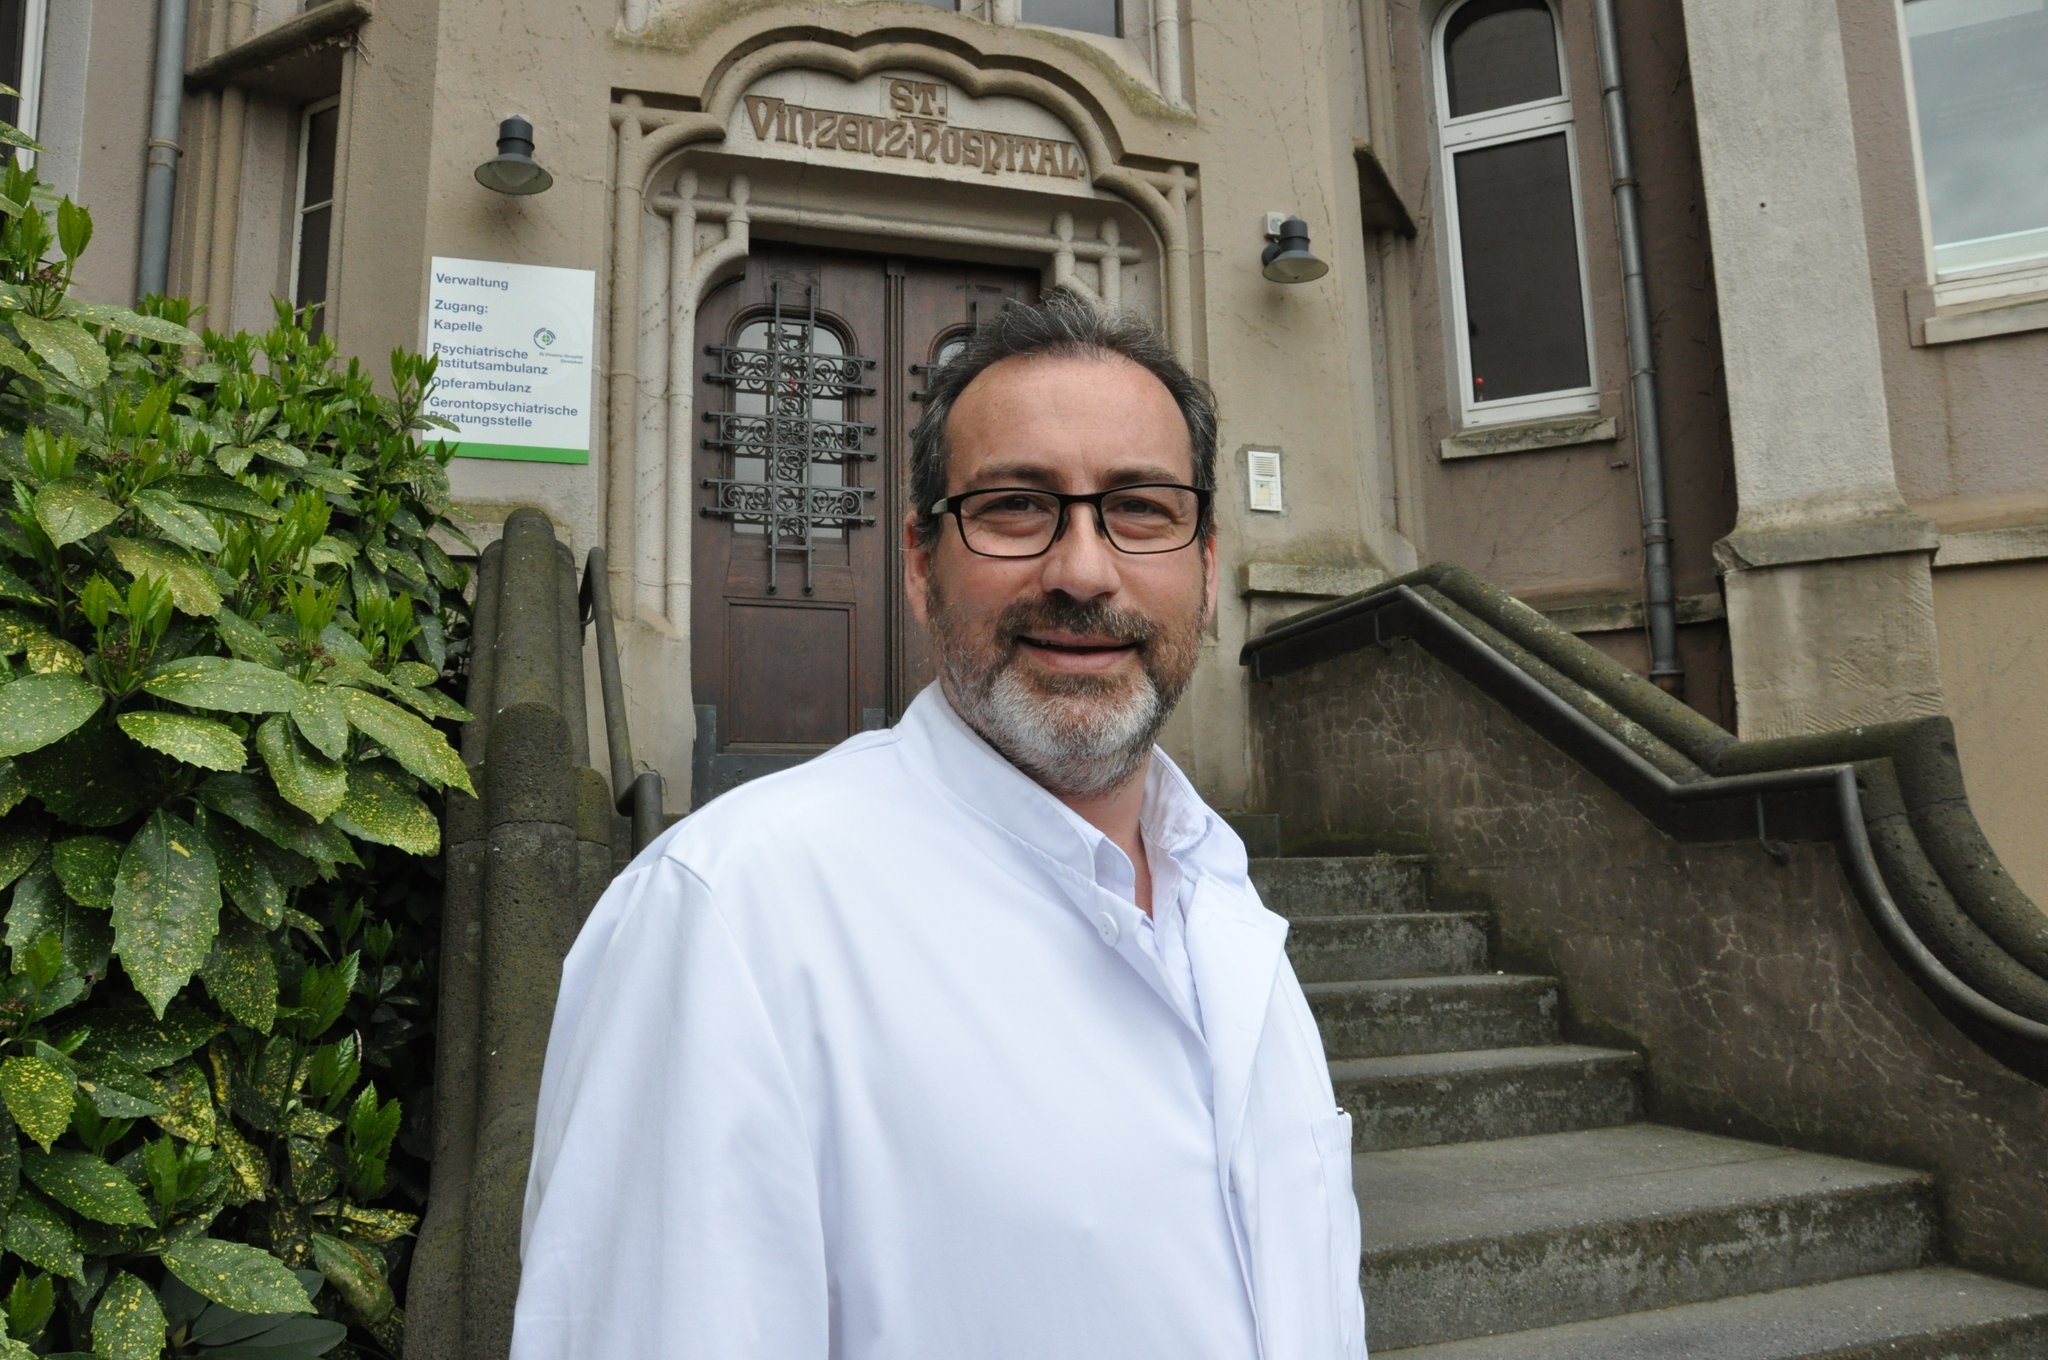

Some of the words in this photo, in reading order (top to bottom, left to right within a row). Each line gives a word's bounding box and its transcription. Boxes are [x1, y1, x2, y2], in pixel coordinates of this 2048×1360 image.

[889, 80, 946, 116] ST.
[436, 273, 509, 291] Verwaltung
[434, 299, 488, 315] Zugang:
[433, 319, 483, 333] Kapelle
[432, 342, 528, 359] Psychiatrische
[438, 358, 548, 375] nstitutsambulanz
[431, 377, 532, 393] Opferambulanz
[429, 396, 578, 416] Gerontopsychiatrische
